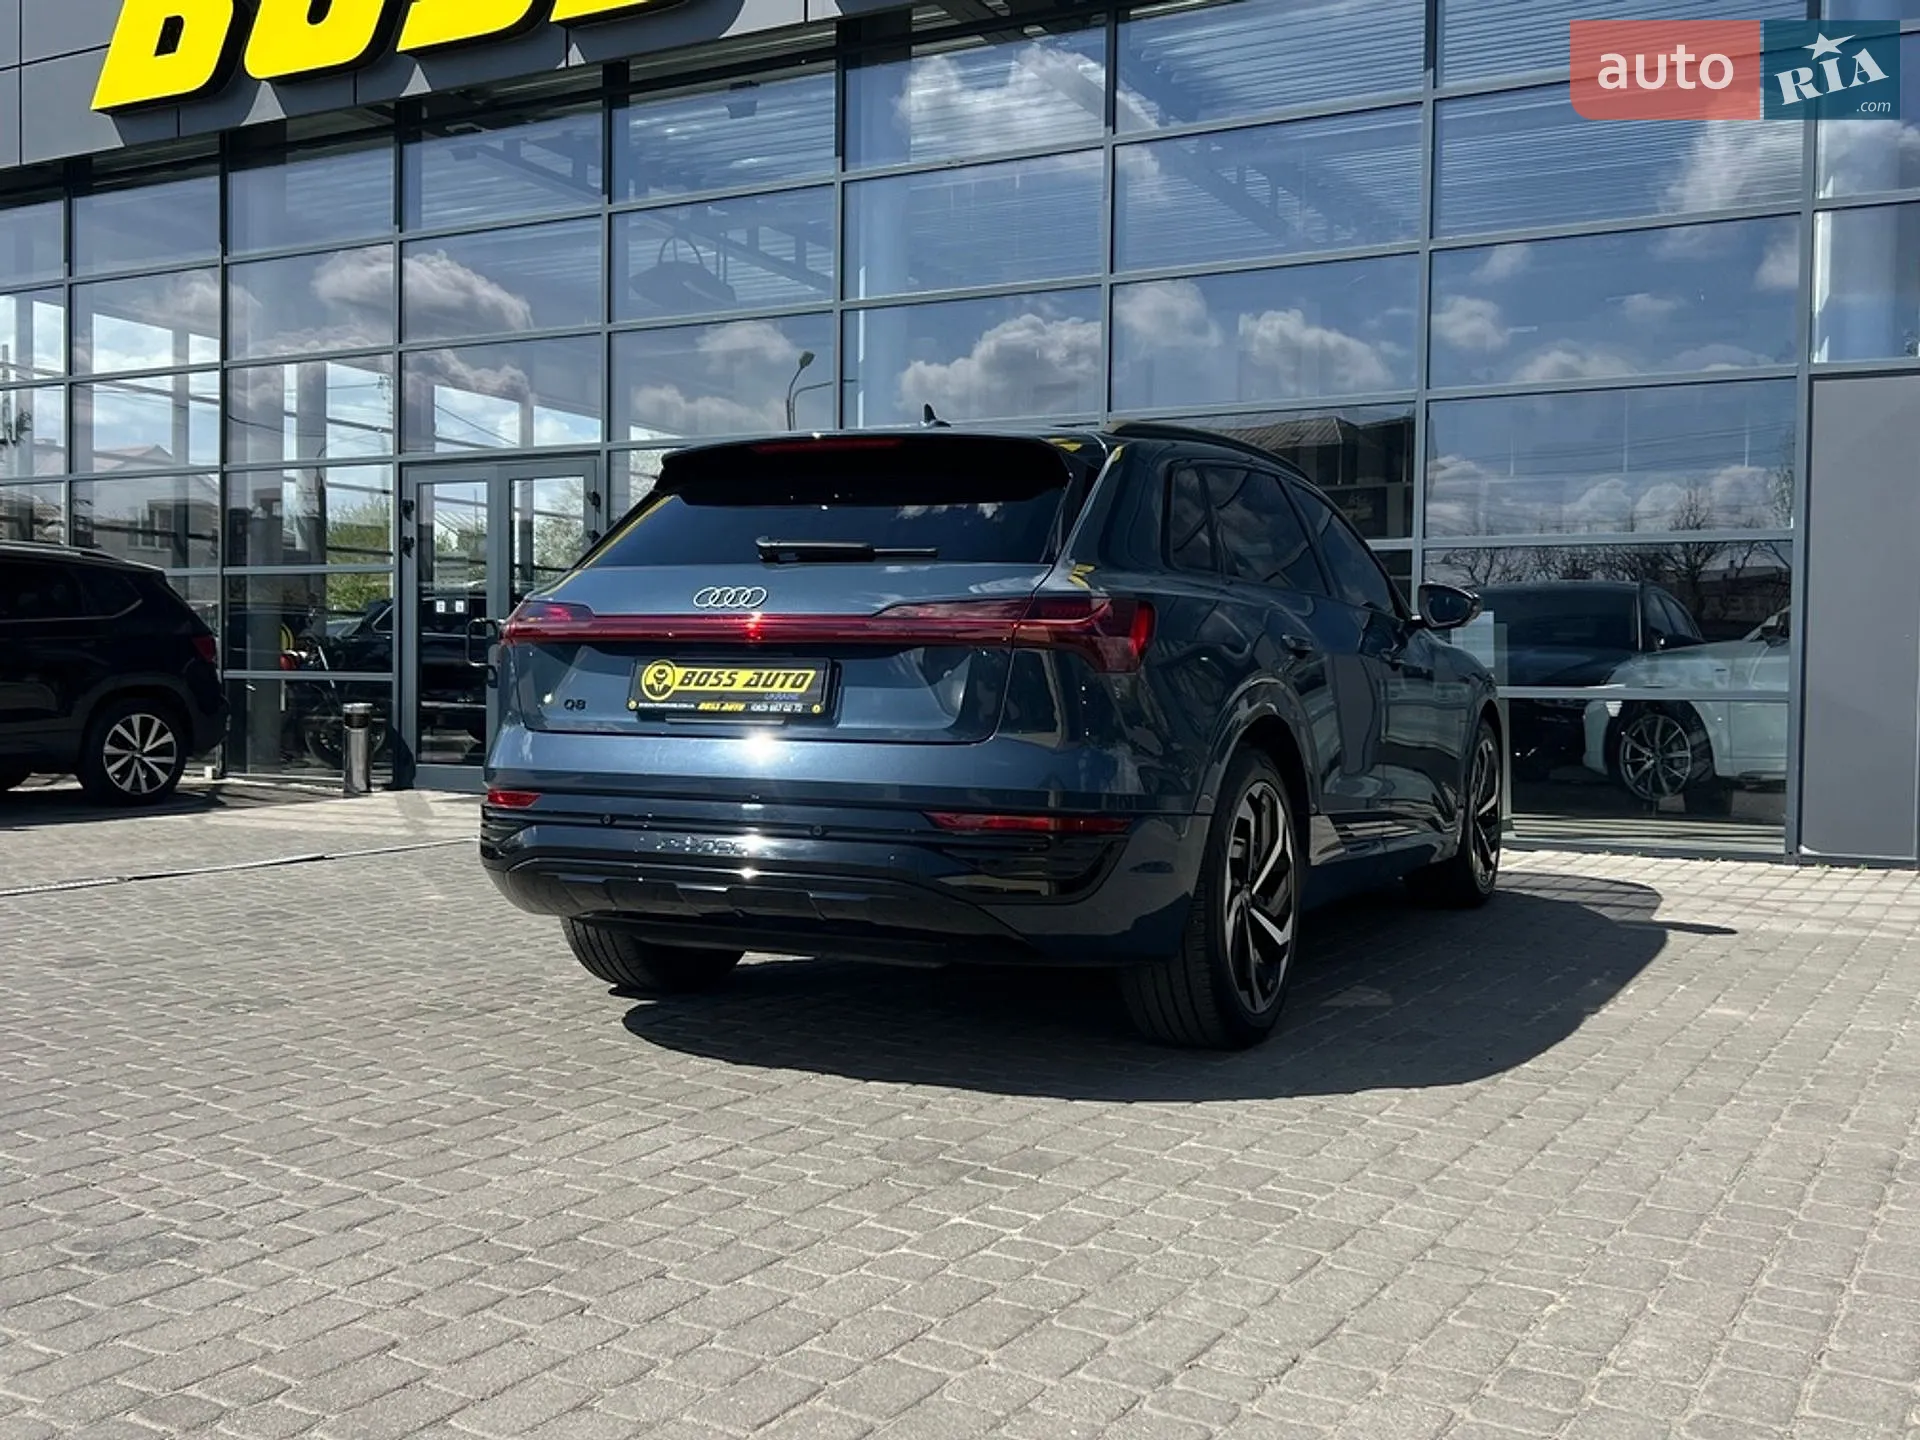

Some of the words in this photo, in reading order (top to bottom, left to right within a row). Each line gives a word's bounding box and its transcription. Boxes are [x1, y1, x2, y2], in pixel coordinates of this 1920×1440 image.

[678, 670, 739, 687] BOSS
[743, 672, 811, 689] AUTO
[564, 699, 586, 711] Q8
